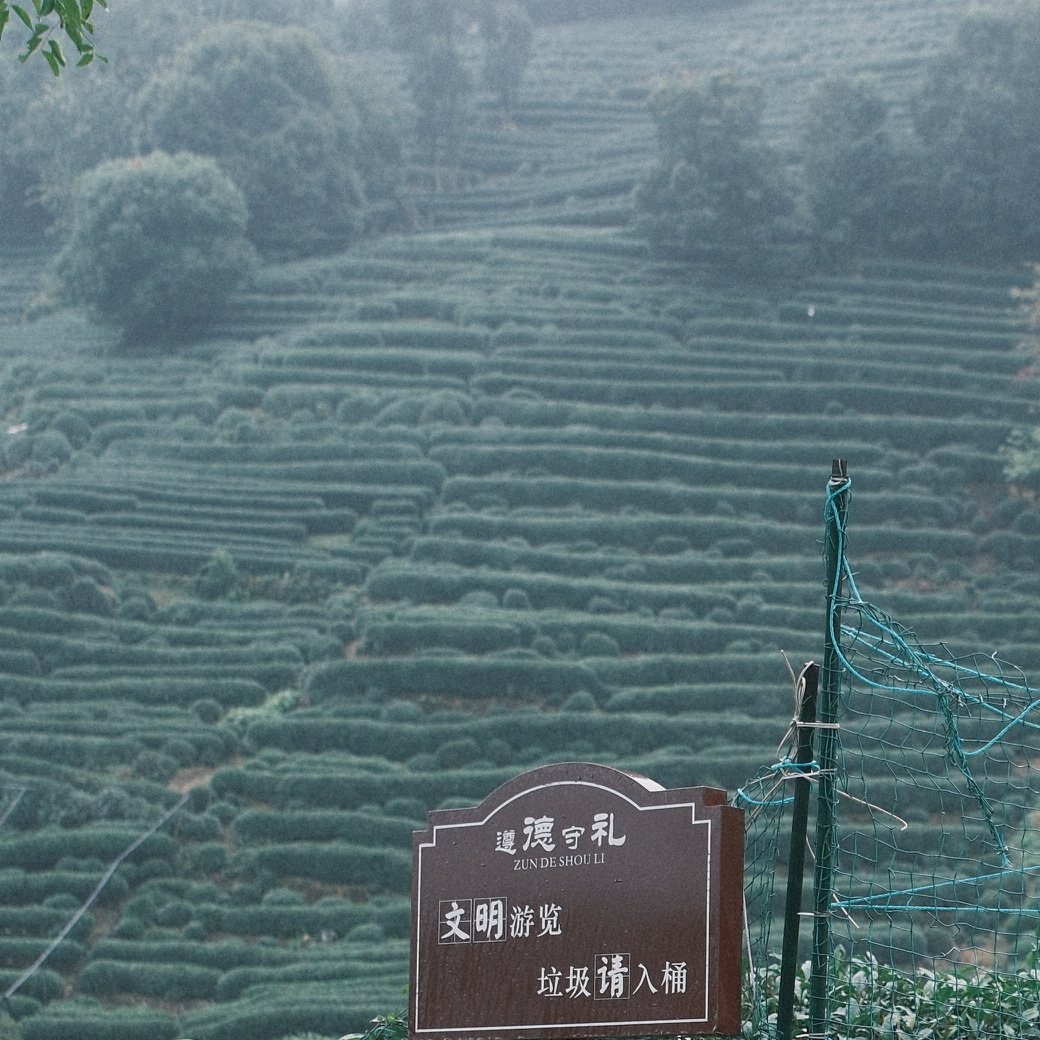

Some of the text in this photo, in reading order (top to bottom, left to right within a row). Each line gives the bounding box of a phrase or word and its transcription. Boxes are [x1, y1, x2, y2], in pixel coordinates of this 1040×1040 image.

[495, 812, 626, 855] 遵德守礼
[513, 852, 605, 871] ZUN DE SHOU LI
[440, 899, 562, 939] 文明游览
[537, 954, 687, 998] 垃圾请入桶
